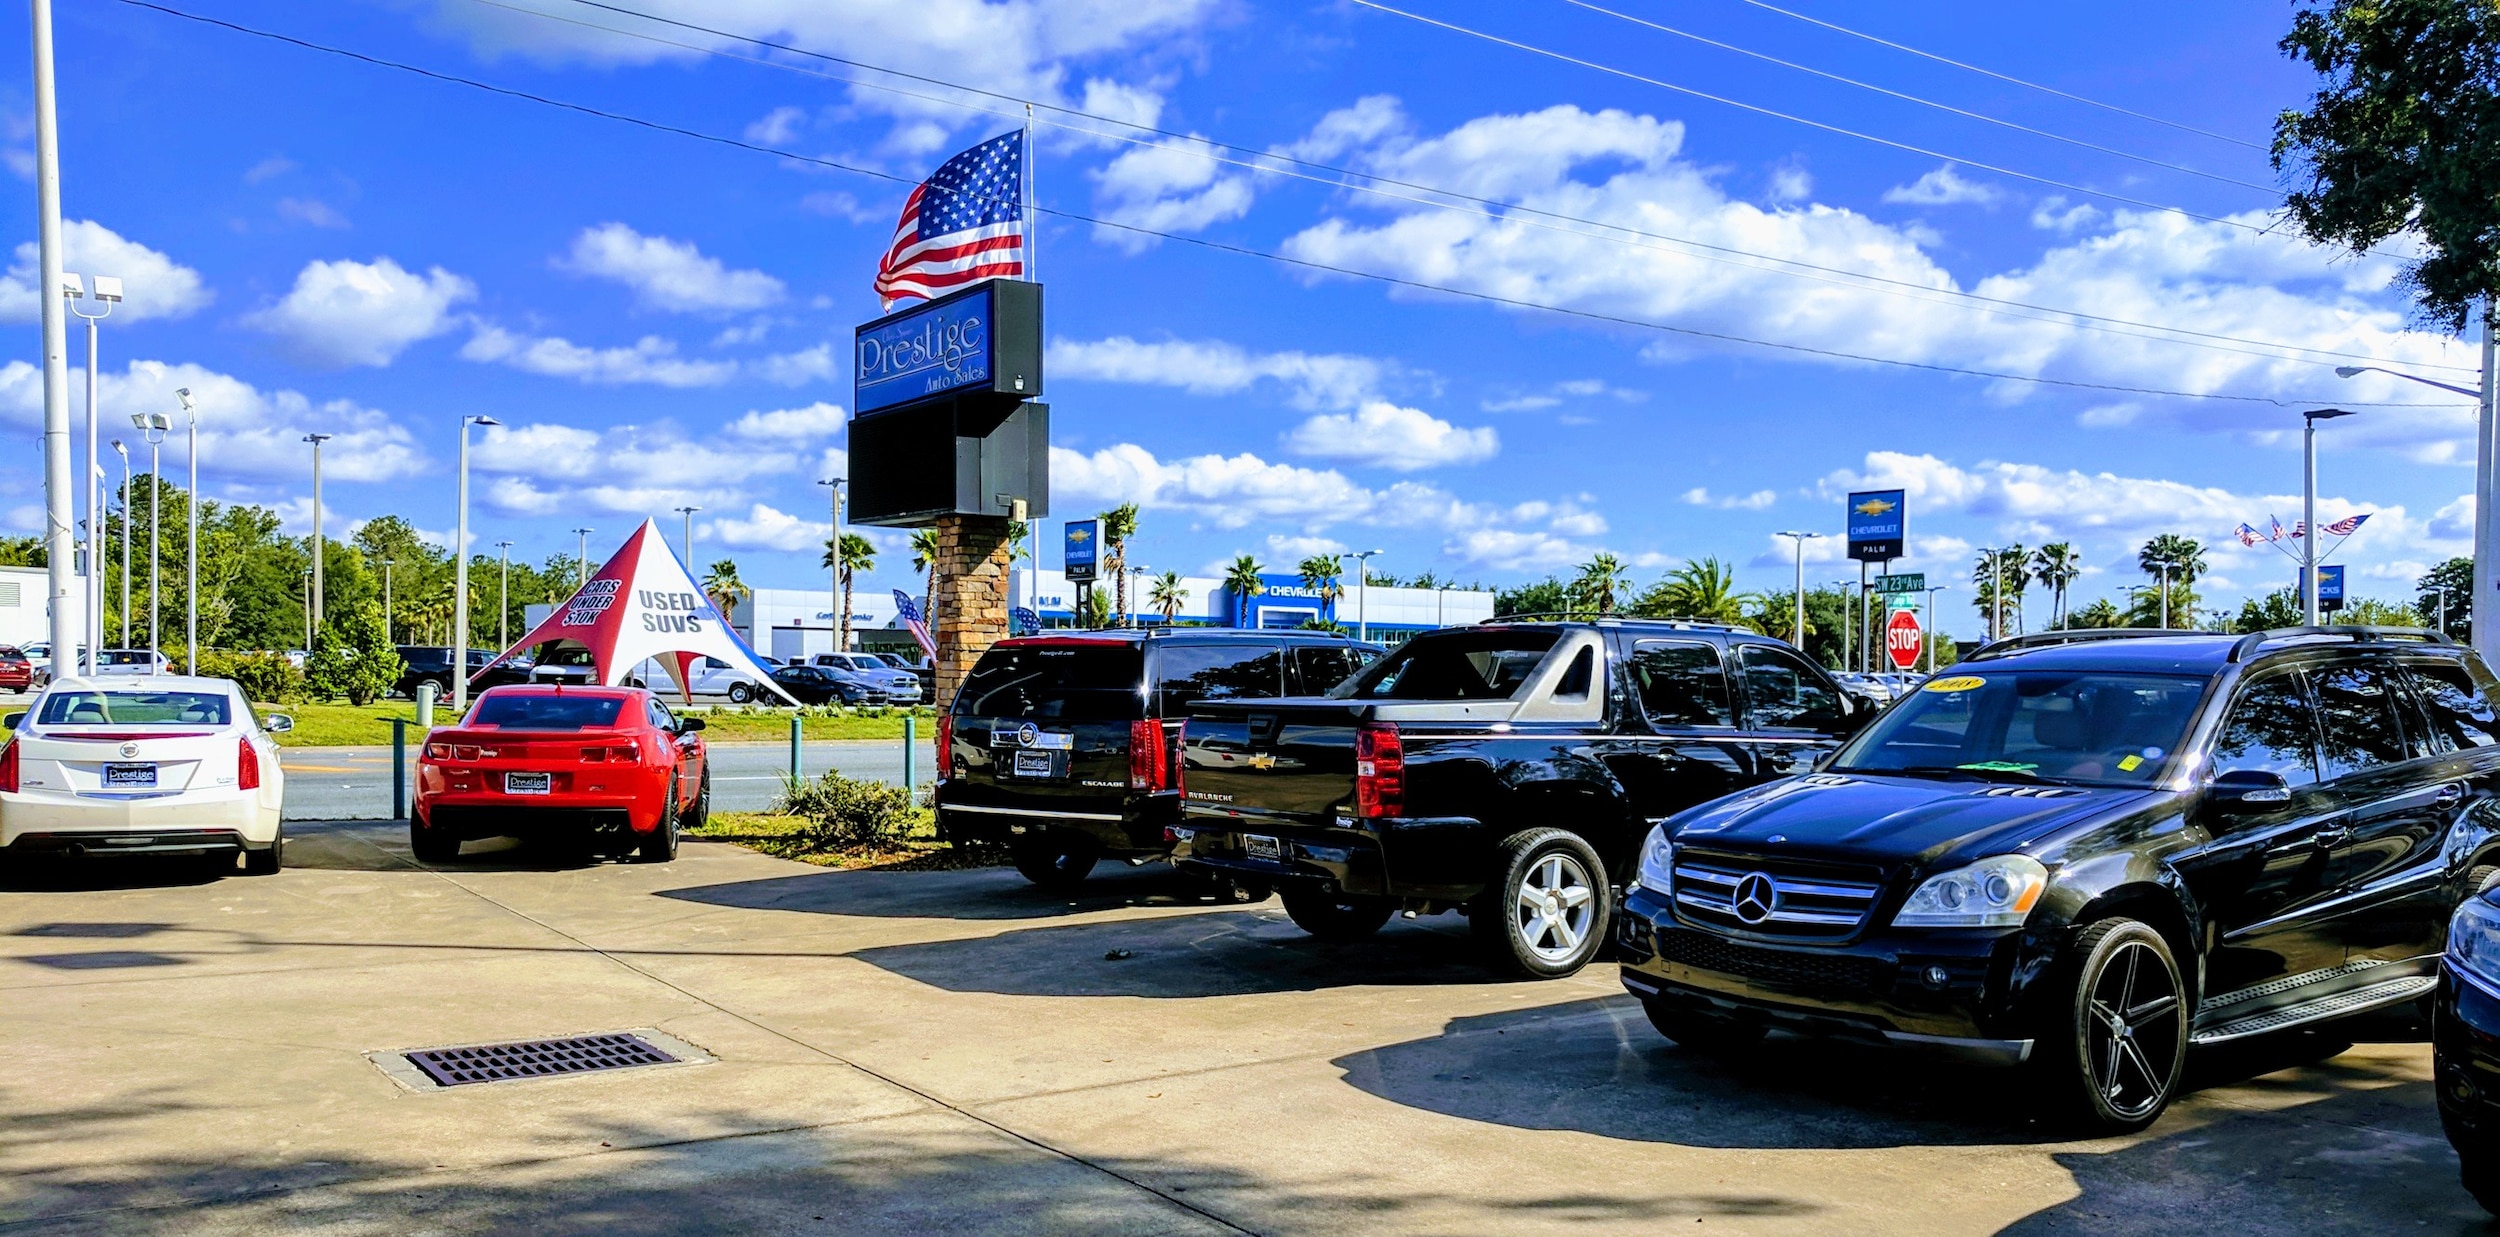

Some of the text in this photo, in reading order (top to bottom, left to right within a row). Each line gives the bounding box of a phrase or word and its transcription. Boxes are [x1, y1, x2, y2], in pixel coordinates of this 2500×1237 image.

[858, 316, 982, 380] Prestige
[925, 364, 985, 393] Auto Sales
[1850, 524, 1898, 535] CHEVROLET
[1863, 545, 1886, 553] PALM
[584, 579, 621, 595] CARS
[1875, 576, 1924, 592] SW 23rd Ave
[1270, 585, 1322, 598] CHEVROLE
[570, 596, 614, 610] UNDER
[638, 589, 696, 611] USED
[642, 612, 702, 633] SUVS
[1889, 628, 1919, 651] STOP
[1019, 757, 1048, 770] Prestige
[109, 769, 154, 781] Prestige
[510, 777, 546, 788] Prestige
[1081, 780, 1125, 788] ESCALADE
[1188, 791, 1233, 802] AVALANCHE
[1249, 841, 1278, 856] Prestige
